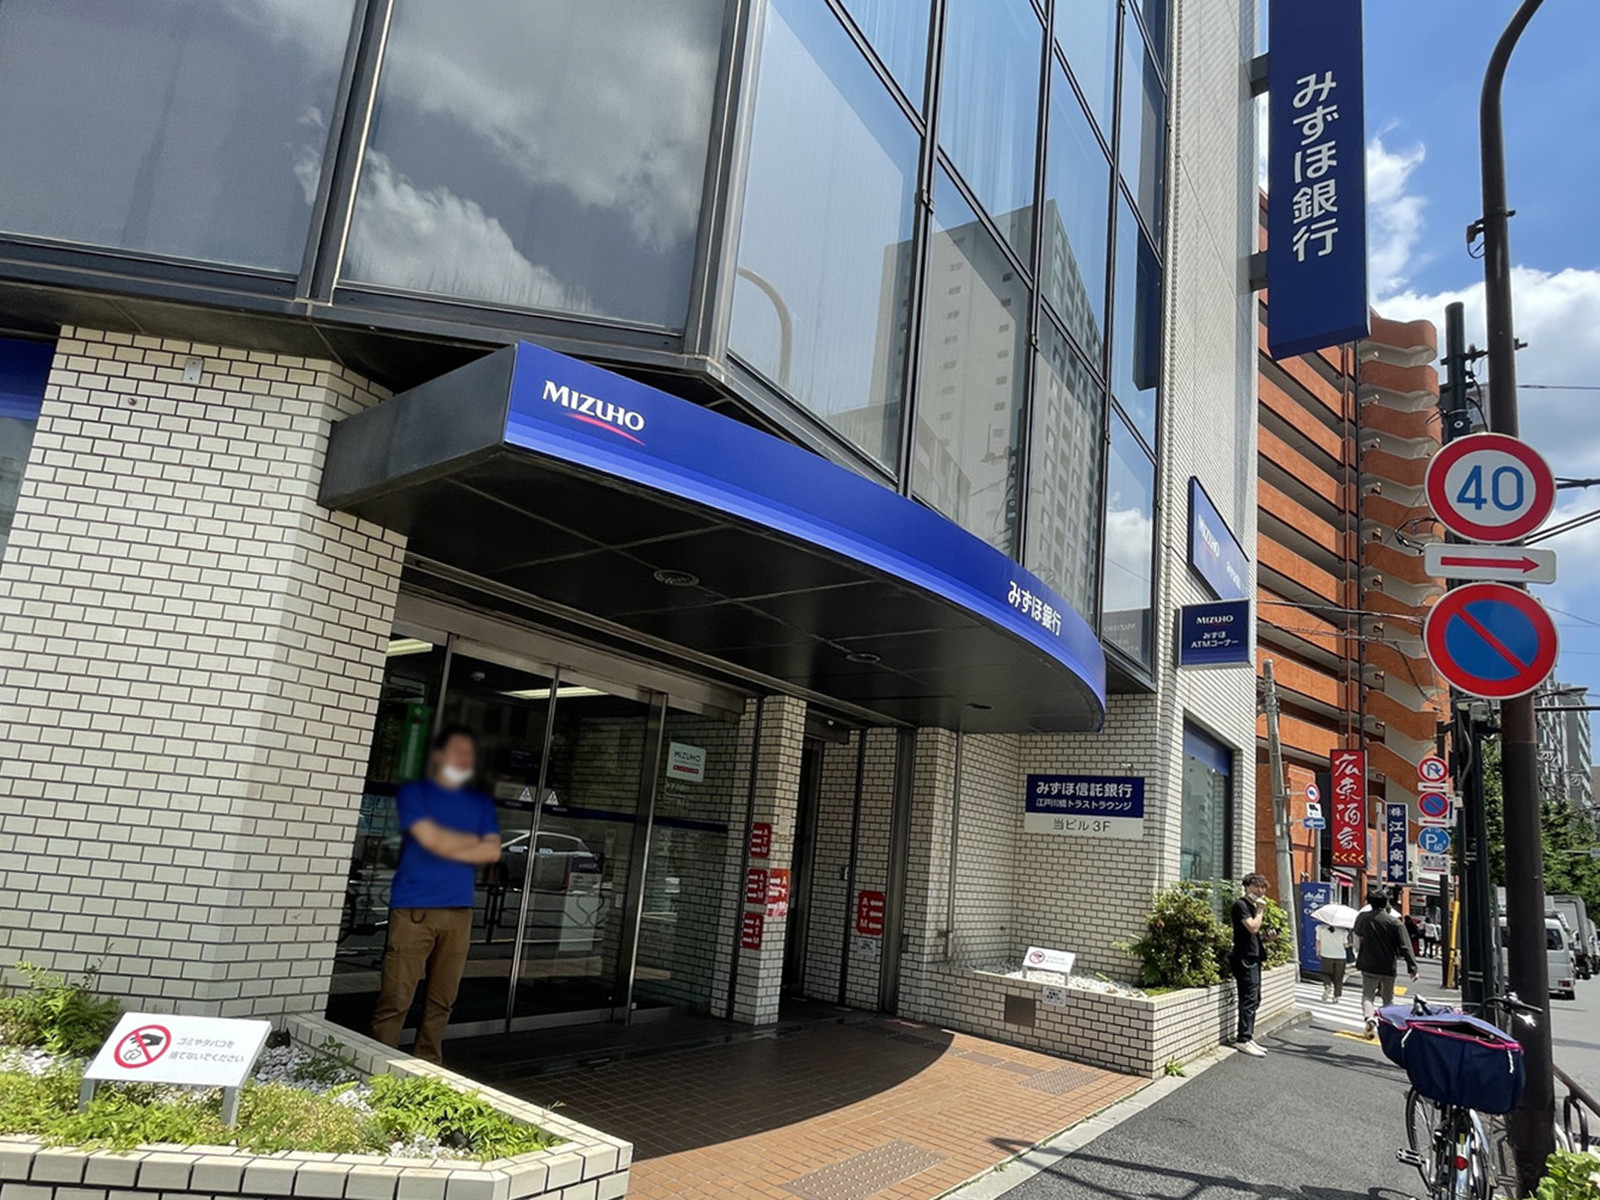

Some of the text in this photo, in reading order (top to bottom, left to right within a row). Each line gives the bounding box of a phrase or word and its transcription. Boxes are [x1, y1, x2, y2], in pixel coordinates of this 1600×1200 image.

[1292, 70, 1339, 262] みずほ銀行
[542, 379, 645, 431] MIZUHO
[1456, 464, 1525, 512] 40
[1008, 580, 1061, 637] みずほ銀行
[1196, 614, 1234, 625] MIZUHO
[1190, 639, 1239, 649] ATMコーナー
[1203, 630, 1227, 640] みずほ
[1036, 781, 1133, 798] みずほ信託銀行
[1334, 753, 1362, 851] 広東酒家
[761, 828, 769, 854] ATM
[860, 896, 869, 928] ATM
